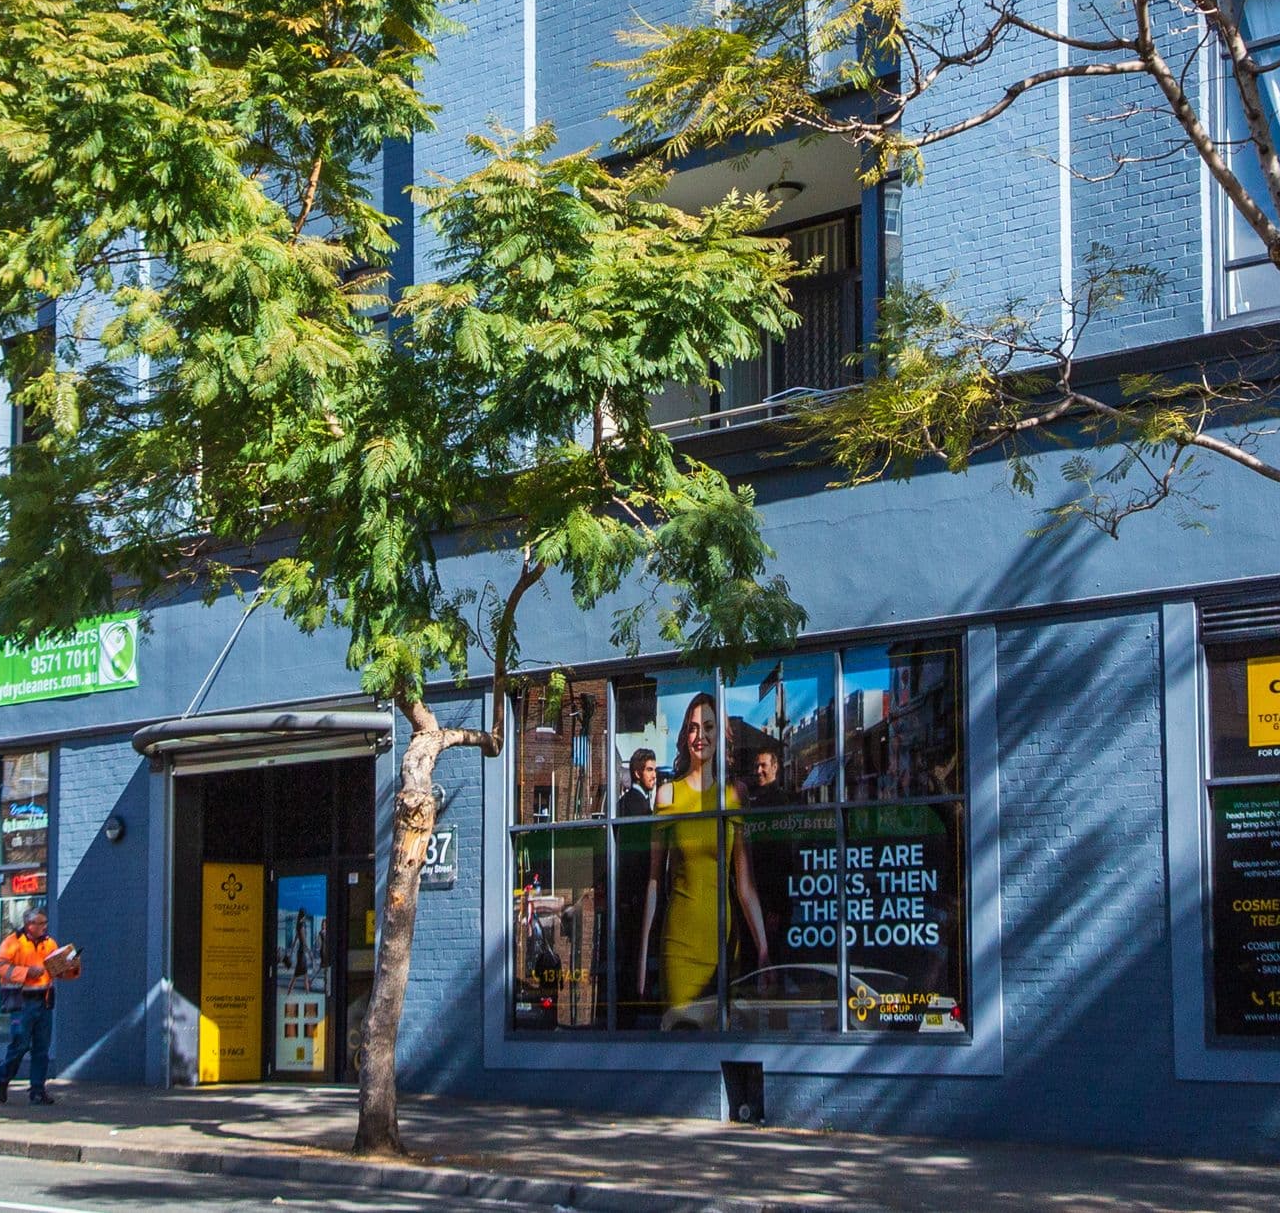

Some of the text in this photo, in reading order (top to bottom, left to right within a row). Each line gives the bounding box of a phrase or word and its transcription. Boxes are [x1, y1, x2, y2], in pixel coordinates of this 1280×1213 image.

[31, 647, 97, 676] 9571 7011
[1258, 749, 1273, 757] FOR
[799, 844, 924, 871] THERE ARE
[876, 869, 938, 894] THEN
[799, 897, 925, 922] THERE ARE
[787, 923, 940, 948] GOOD LOOKS
[543, 969, 556, 983] 13
[1261, 966, 1280, 974] SKIN
[880, 1004, 911, 1014] GROUP
[893, 1013, 914, 1022] GOOD
